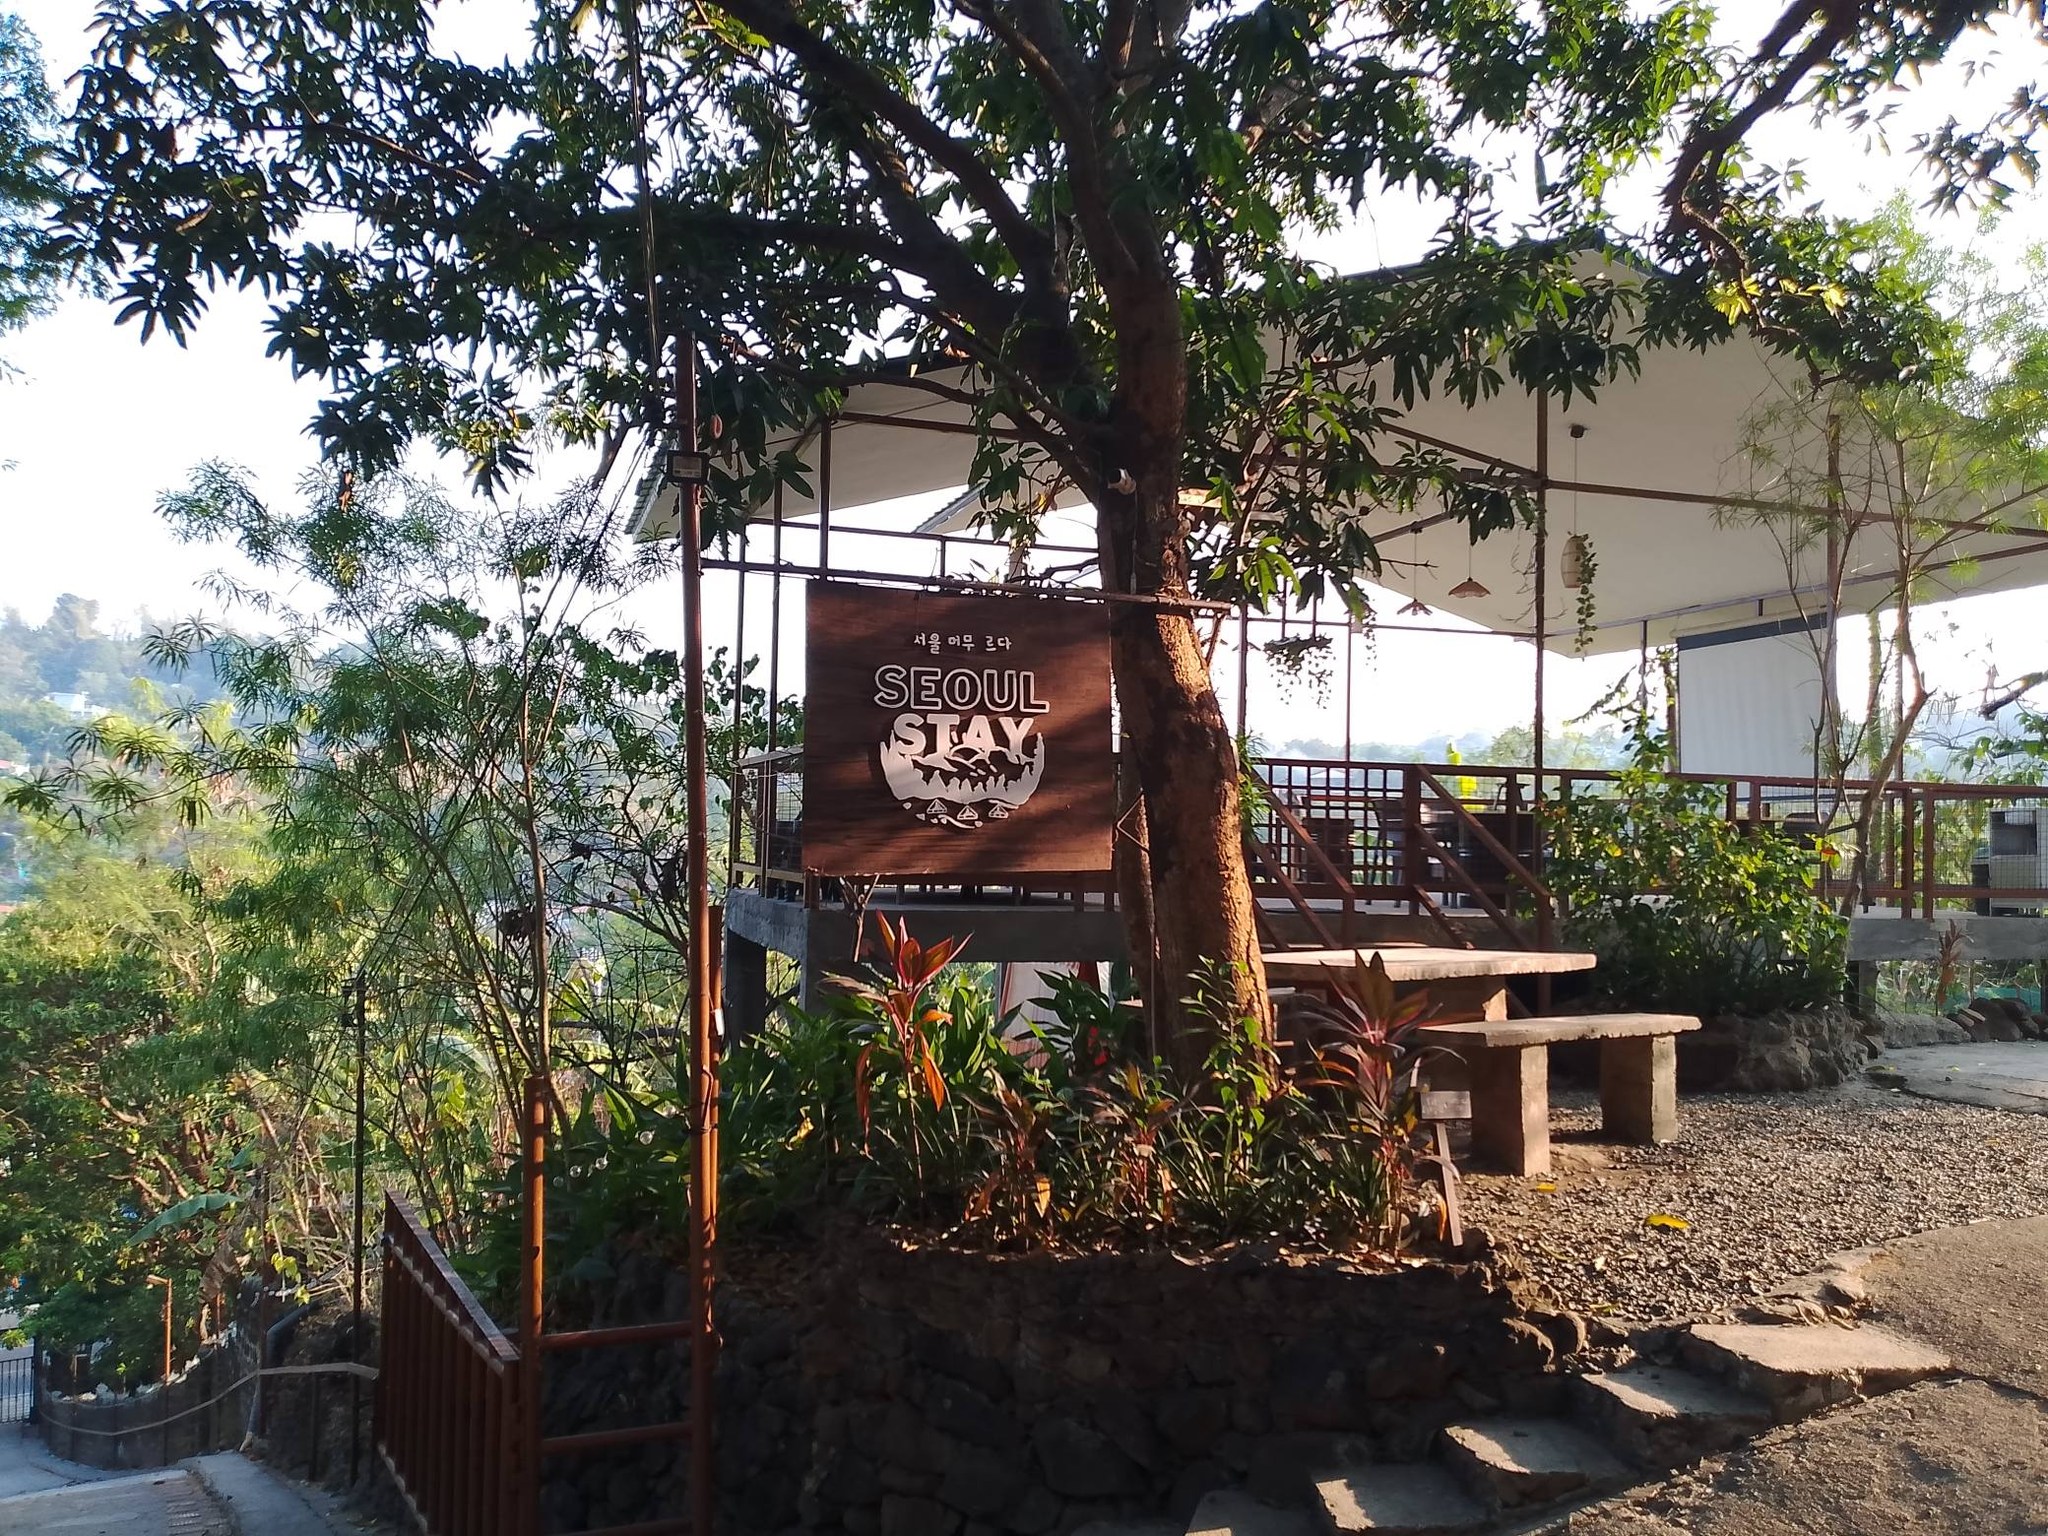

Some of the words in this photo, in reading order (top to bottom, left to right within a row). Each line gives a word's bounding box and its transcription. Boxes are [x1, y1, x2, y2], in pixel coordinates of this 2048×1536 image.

[913, 632, 941, 655] 서울
[873, 664, 1050, 713] SEOUL
[893, 713, 1035, 757] STAY
